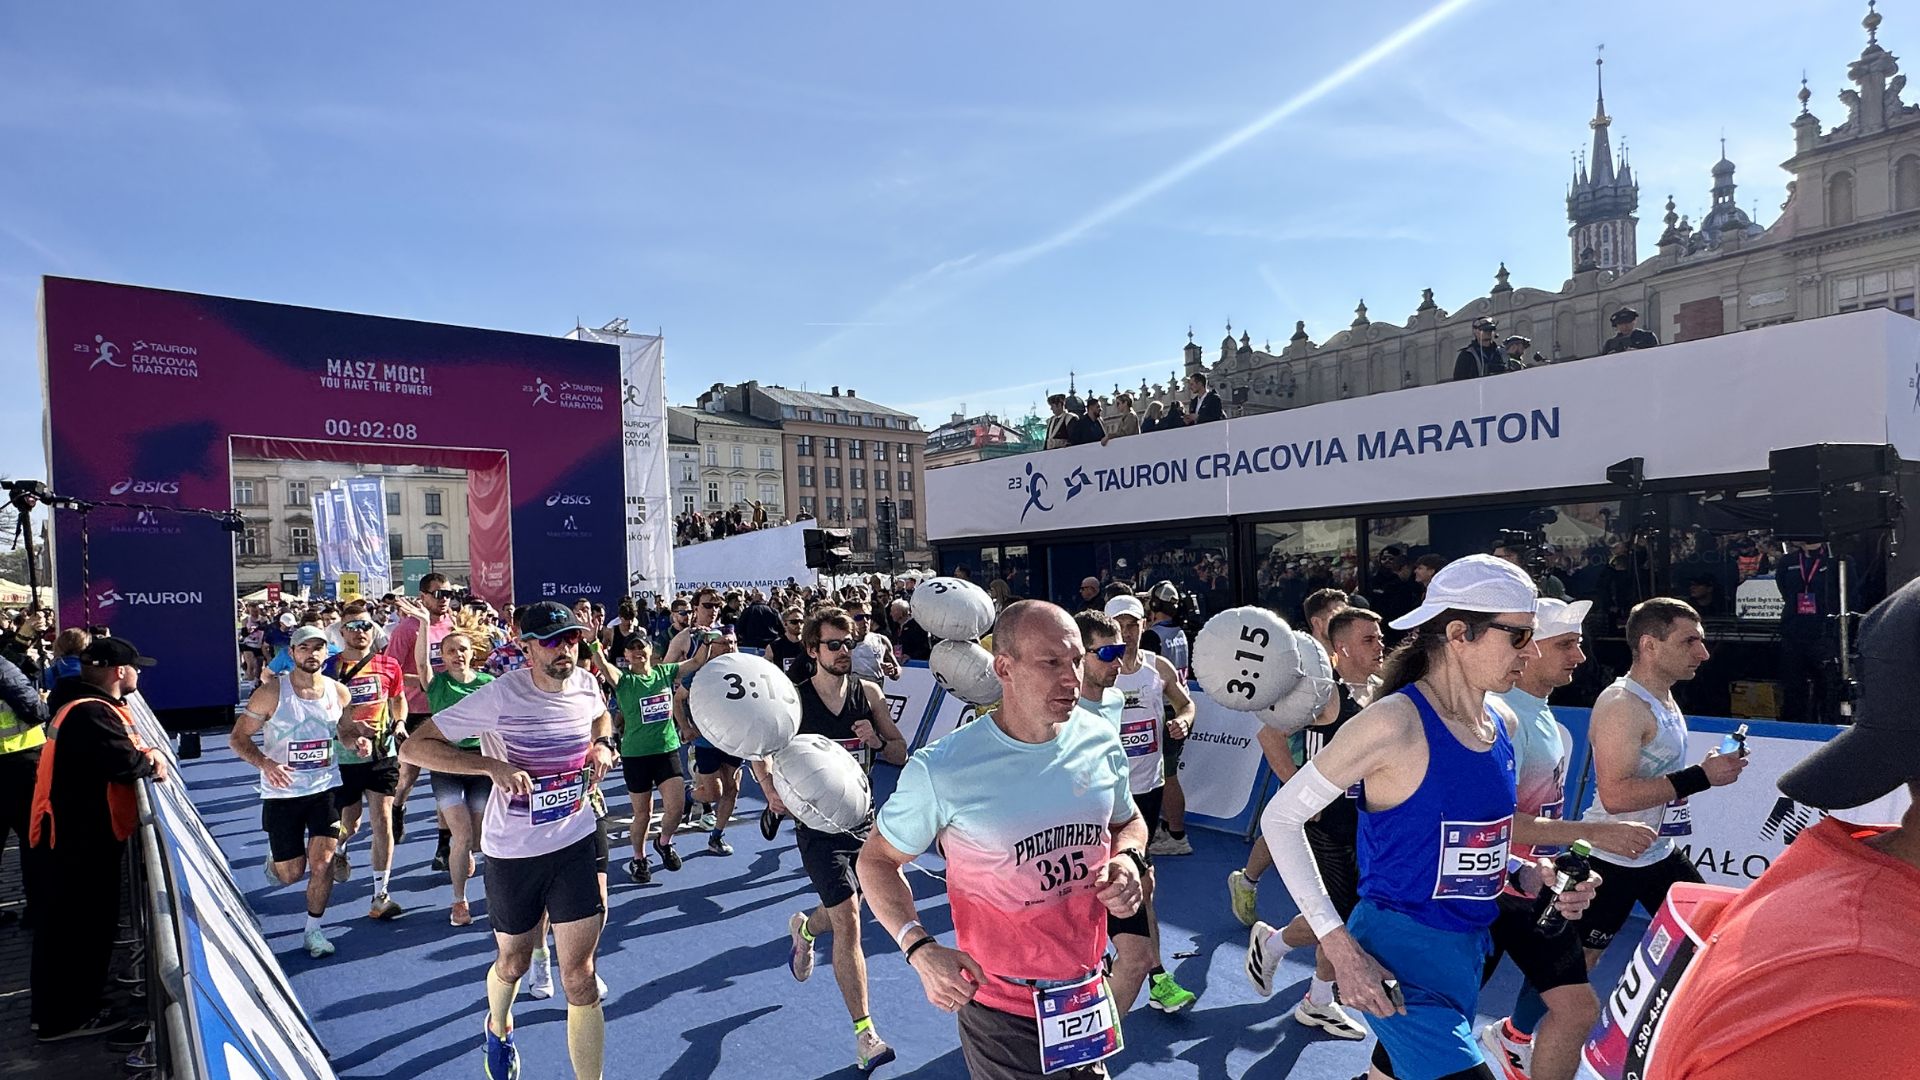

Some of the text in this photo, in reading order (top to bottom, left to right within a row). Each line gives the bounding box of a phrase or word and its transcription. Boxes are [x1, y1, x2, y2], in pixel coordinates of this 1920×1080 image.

[149, 342, 197, 356] TAURON
[131, 354, 198, 369] CRACOVIA
[132, 363, 198, 378] MARATON
[327, 358, 425, 384] MASZ MOC!
[319, 376, 433, 396] YOU HAVE THE POWER!
[572, 383, 603, 394] TAURON
[560, 392, 603, 404] CRACOVIA
[560, 400, 604, 411] MARATON
[325, 419, 418, 440] 00:02:08
[1008, 406, 1560, 492] 23 TAURON CRACOVIA MARATON
[132, 480, 179, 494] asics
[561, 494, 592, 505] asics
[560, 582, 602, 594] Kraków
[710, 580, 755, 589] CRACOVIA
[125, 591, 203, 605] TAURON
[1226, 624, 1270, 701] 3:15
[293, 750, 324, 760] 1043
[538, 788, 578, 807] 1055
[1014, 823, 1103, 867] PACEMAKER
[1457, 849, 1501, 871] 595
[1036, 850, 1089, 892] 3:15
[1057, 1009, 1103, 1039] 1271
[1634, 987, 1668, 1059] 4:30-4:44
